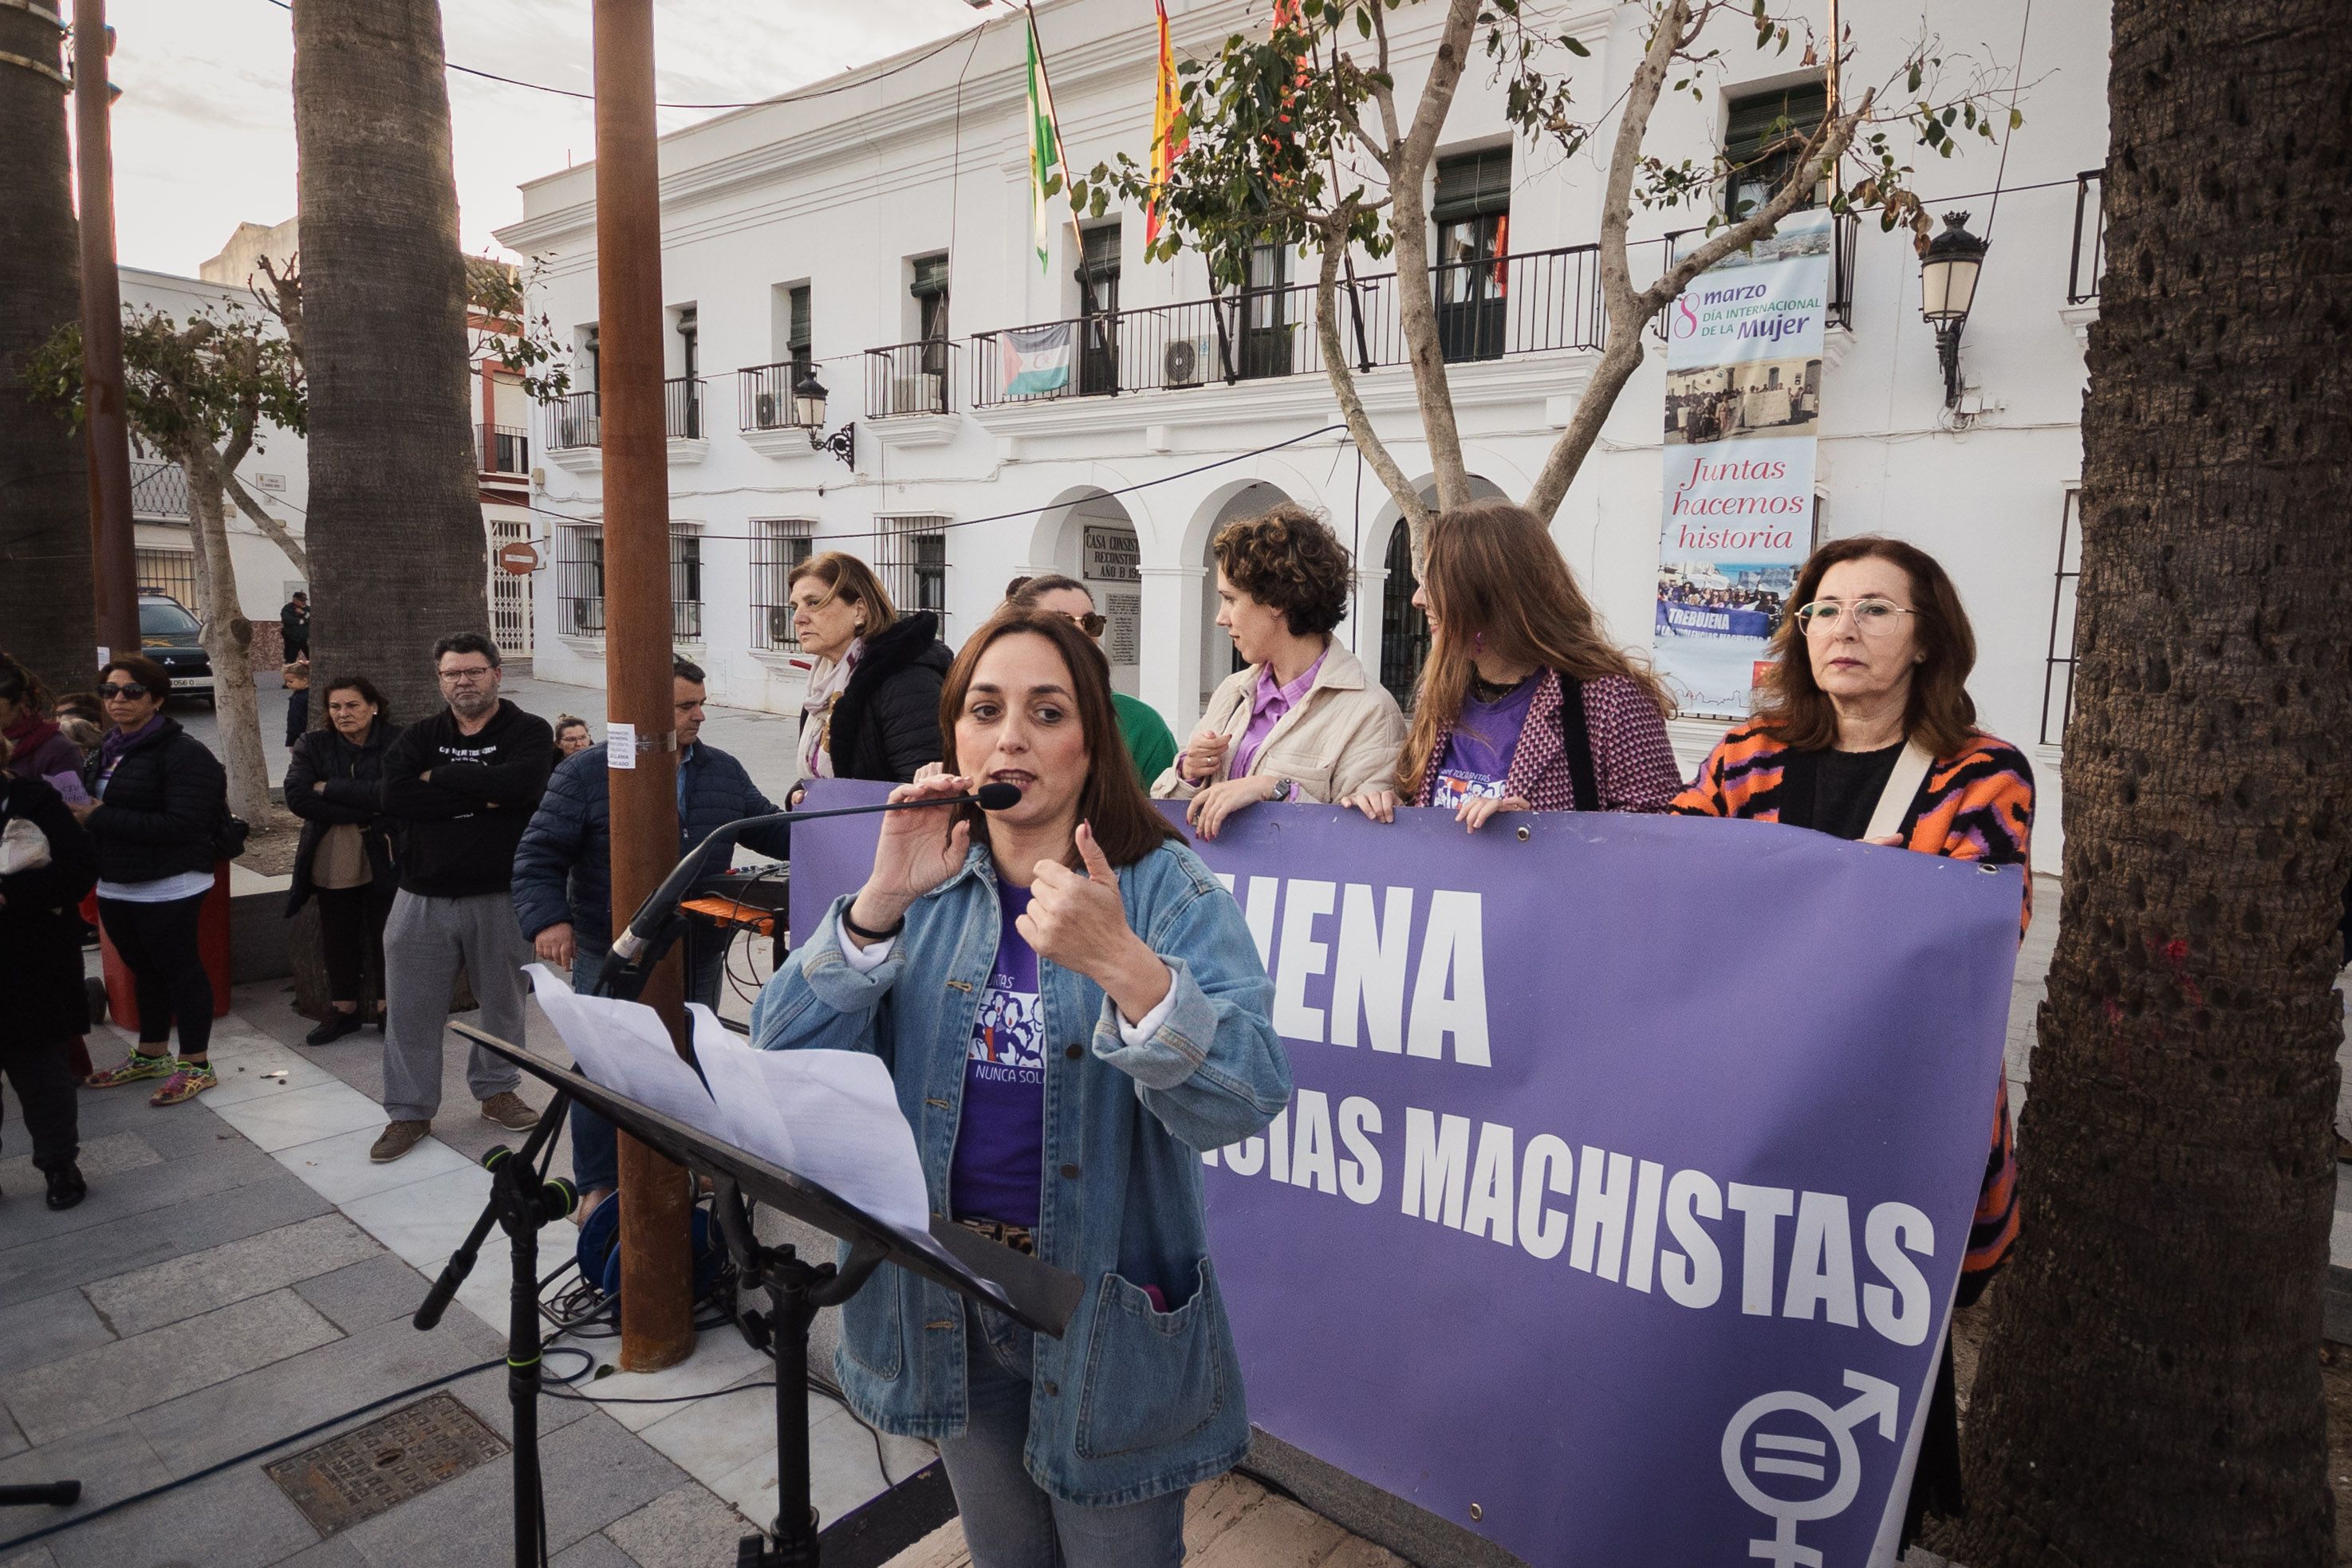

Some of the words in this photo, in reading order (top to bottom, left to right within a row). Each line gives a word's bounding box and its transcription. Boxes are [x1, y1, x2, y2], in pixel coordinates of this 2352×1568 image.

[1703, 283, 1767, 306] marzo
[1673, 292, 1700, 339] 8
[1702, 307, 1723, 323] DÍA
[1725, 297, 1822, 320] INTERNACIONAL
[1701, 324, 1717, 337] DE
[1720, 323, 1735, 335] LA
[1736, 313, 1810, 343] Mujer
[1679, 457, 1787, 491] Juntas
[1672, 490, 1805, 516] hacemos
[1085, 534, 1106, 550] CASA
[1678, 523, 1794, 549] historia
[1100, 564, 1116, 577] AÑO
[1668, 608, 1730, 630] TREBUJENA
[975, 1064, 1017, 1082] NUNCA
[1019, 1070, 1045, 1084] SOL
[1401, 1106, 1935, 1347] MACHISTAS
